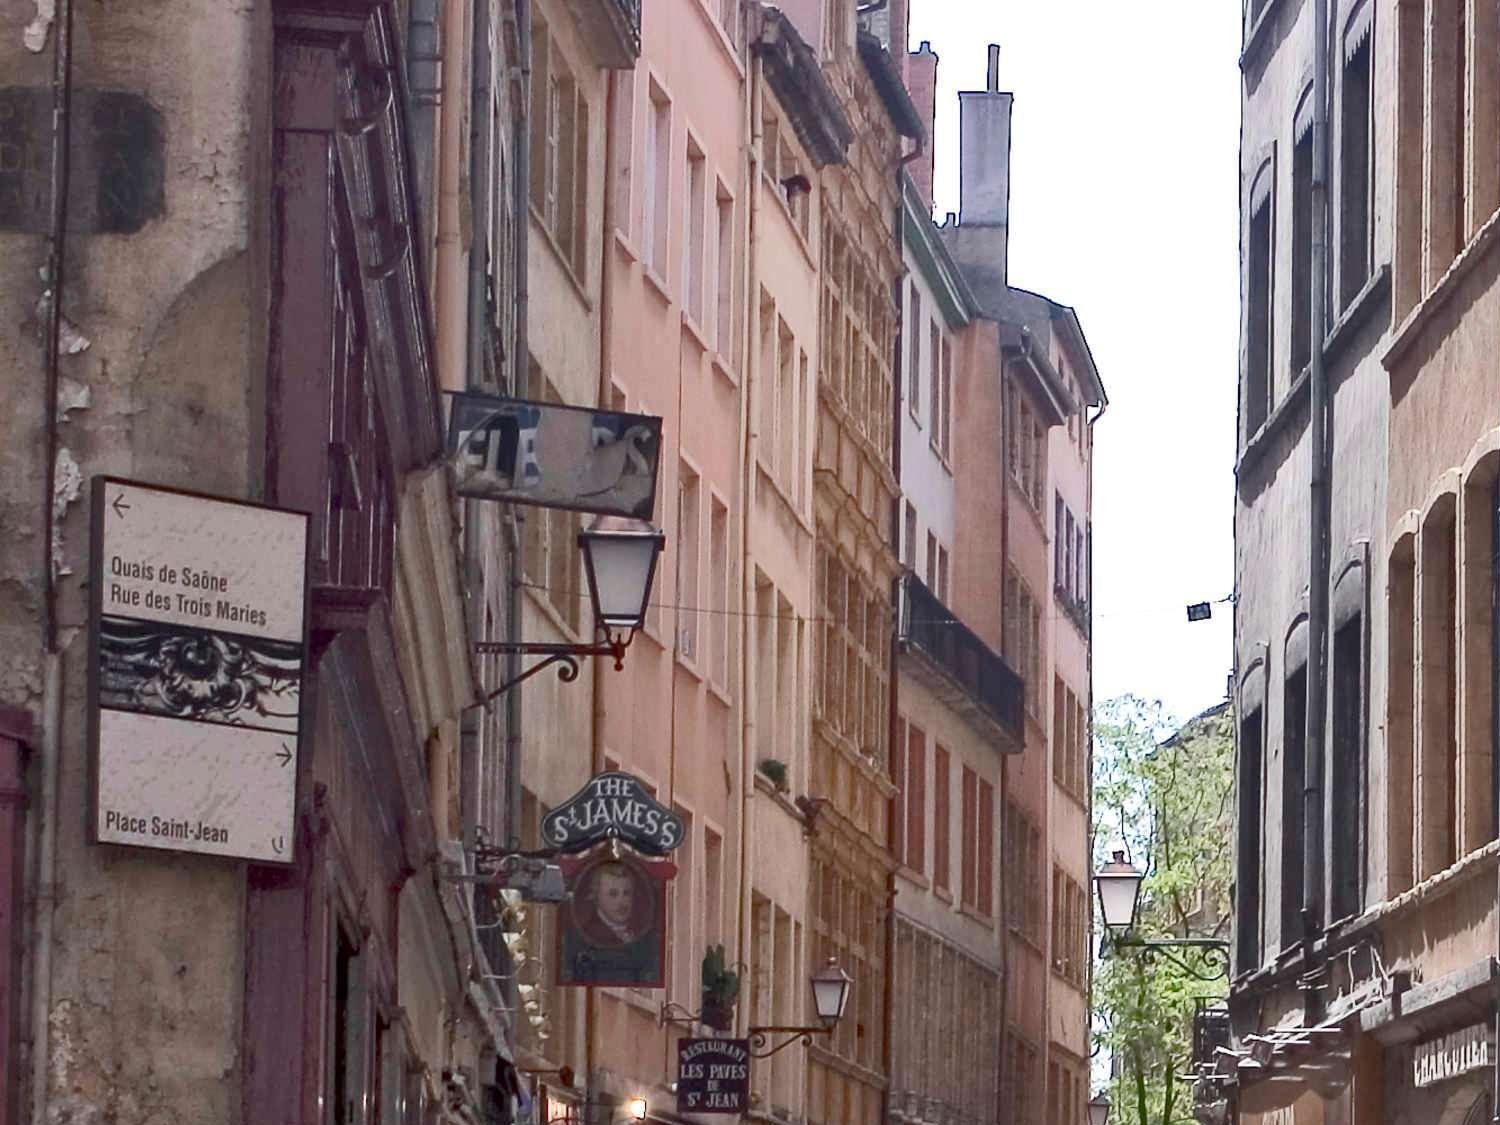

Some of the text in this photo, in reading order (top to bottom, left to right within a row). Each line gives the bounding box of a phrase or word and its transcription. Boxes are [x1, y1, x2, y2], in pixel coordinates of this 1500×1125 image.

[111, 556, 228, 592] Quais de Saône
[111, 583, 267, 626] Rue des Trois Maries
[593, 777, 635, 797] THE
[106, 810, 229, 843] Place Saint-Jean
[681, 1063, 704, 1079] LES
[706, 1092, 739, 1108] JEAN
